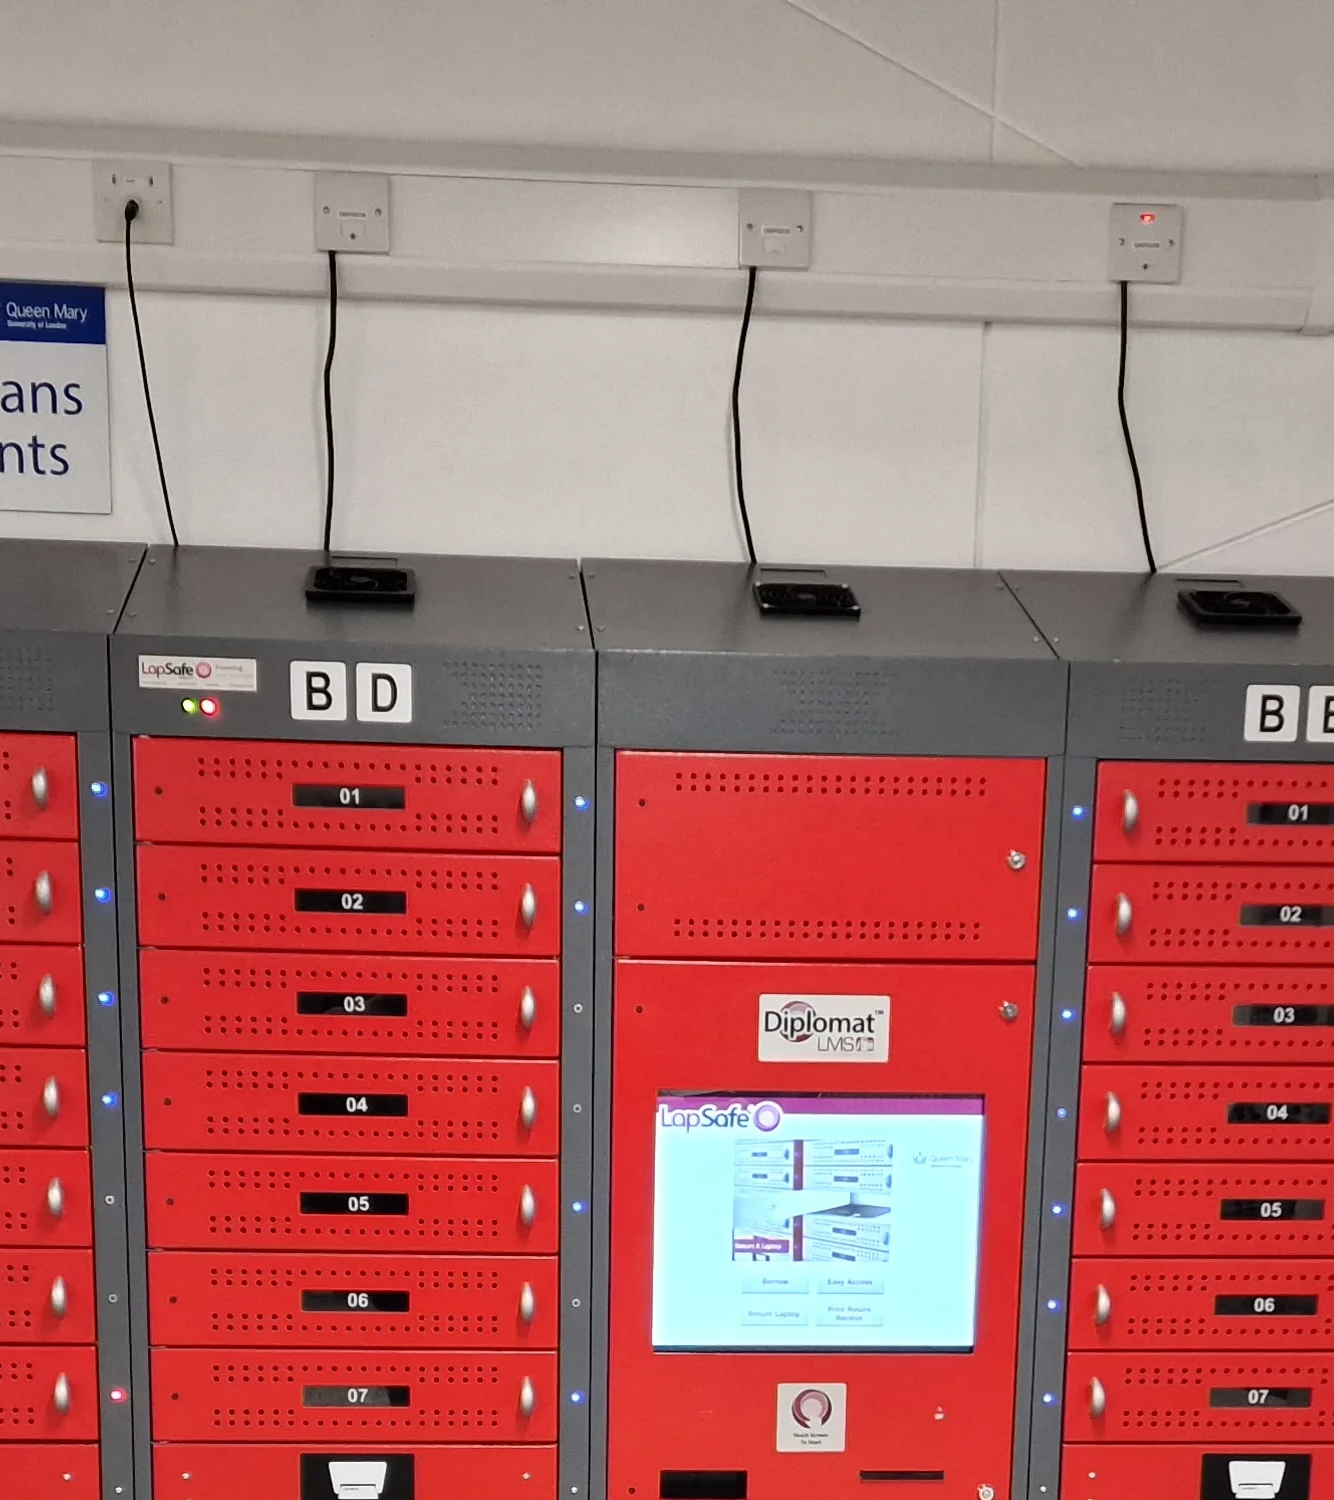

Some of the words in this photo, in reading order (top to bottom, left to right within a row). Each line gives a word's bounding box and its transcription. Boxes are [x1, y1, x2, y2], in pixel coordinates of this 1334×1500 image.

[5, 302, 51, 319] Queen
[54, 303, 88, 323] Mary
[141, 661, 195, 678] LapSafe
[339, 787, 360, 805] 01
[1288, 804, 1309, 821] 01
[341, 893, 364, 910] 02
[1280, 905, 1302, 923] 02
[343, 995, 366, 1013] 03
[1273, 1006, 1295, 1023] 03
[817, 1036, 855, 1053] LMS
[345, 1096, 369, 1113] 04
[1266, 1104, 1289, 1120] 04
[661, 1106, 750, 1133] LapSafe
[348, 1195, 370, 1212] 05
[1260, 1201, 1282, 1218] 05
[347, 1292, 369, 1308] 06
[1253, 1297, 1275, 1313] 06
[347, 1388, 369, 1403] 07
[1247, 1389, 1269, 1404] 07
